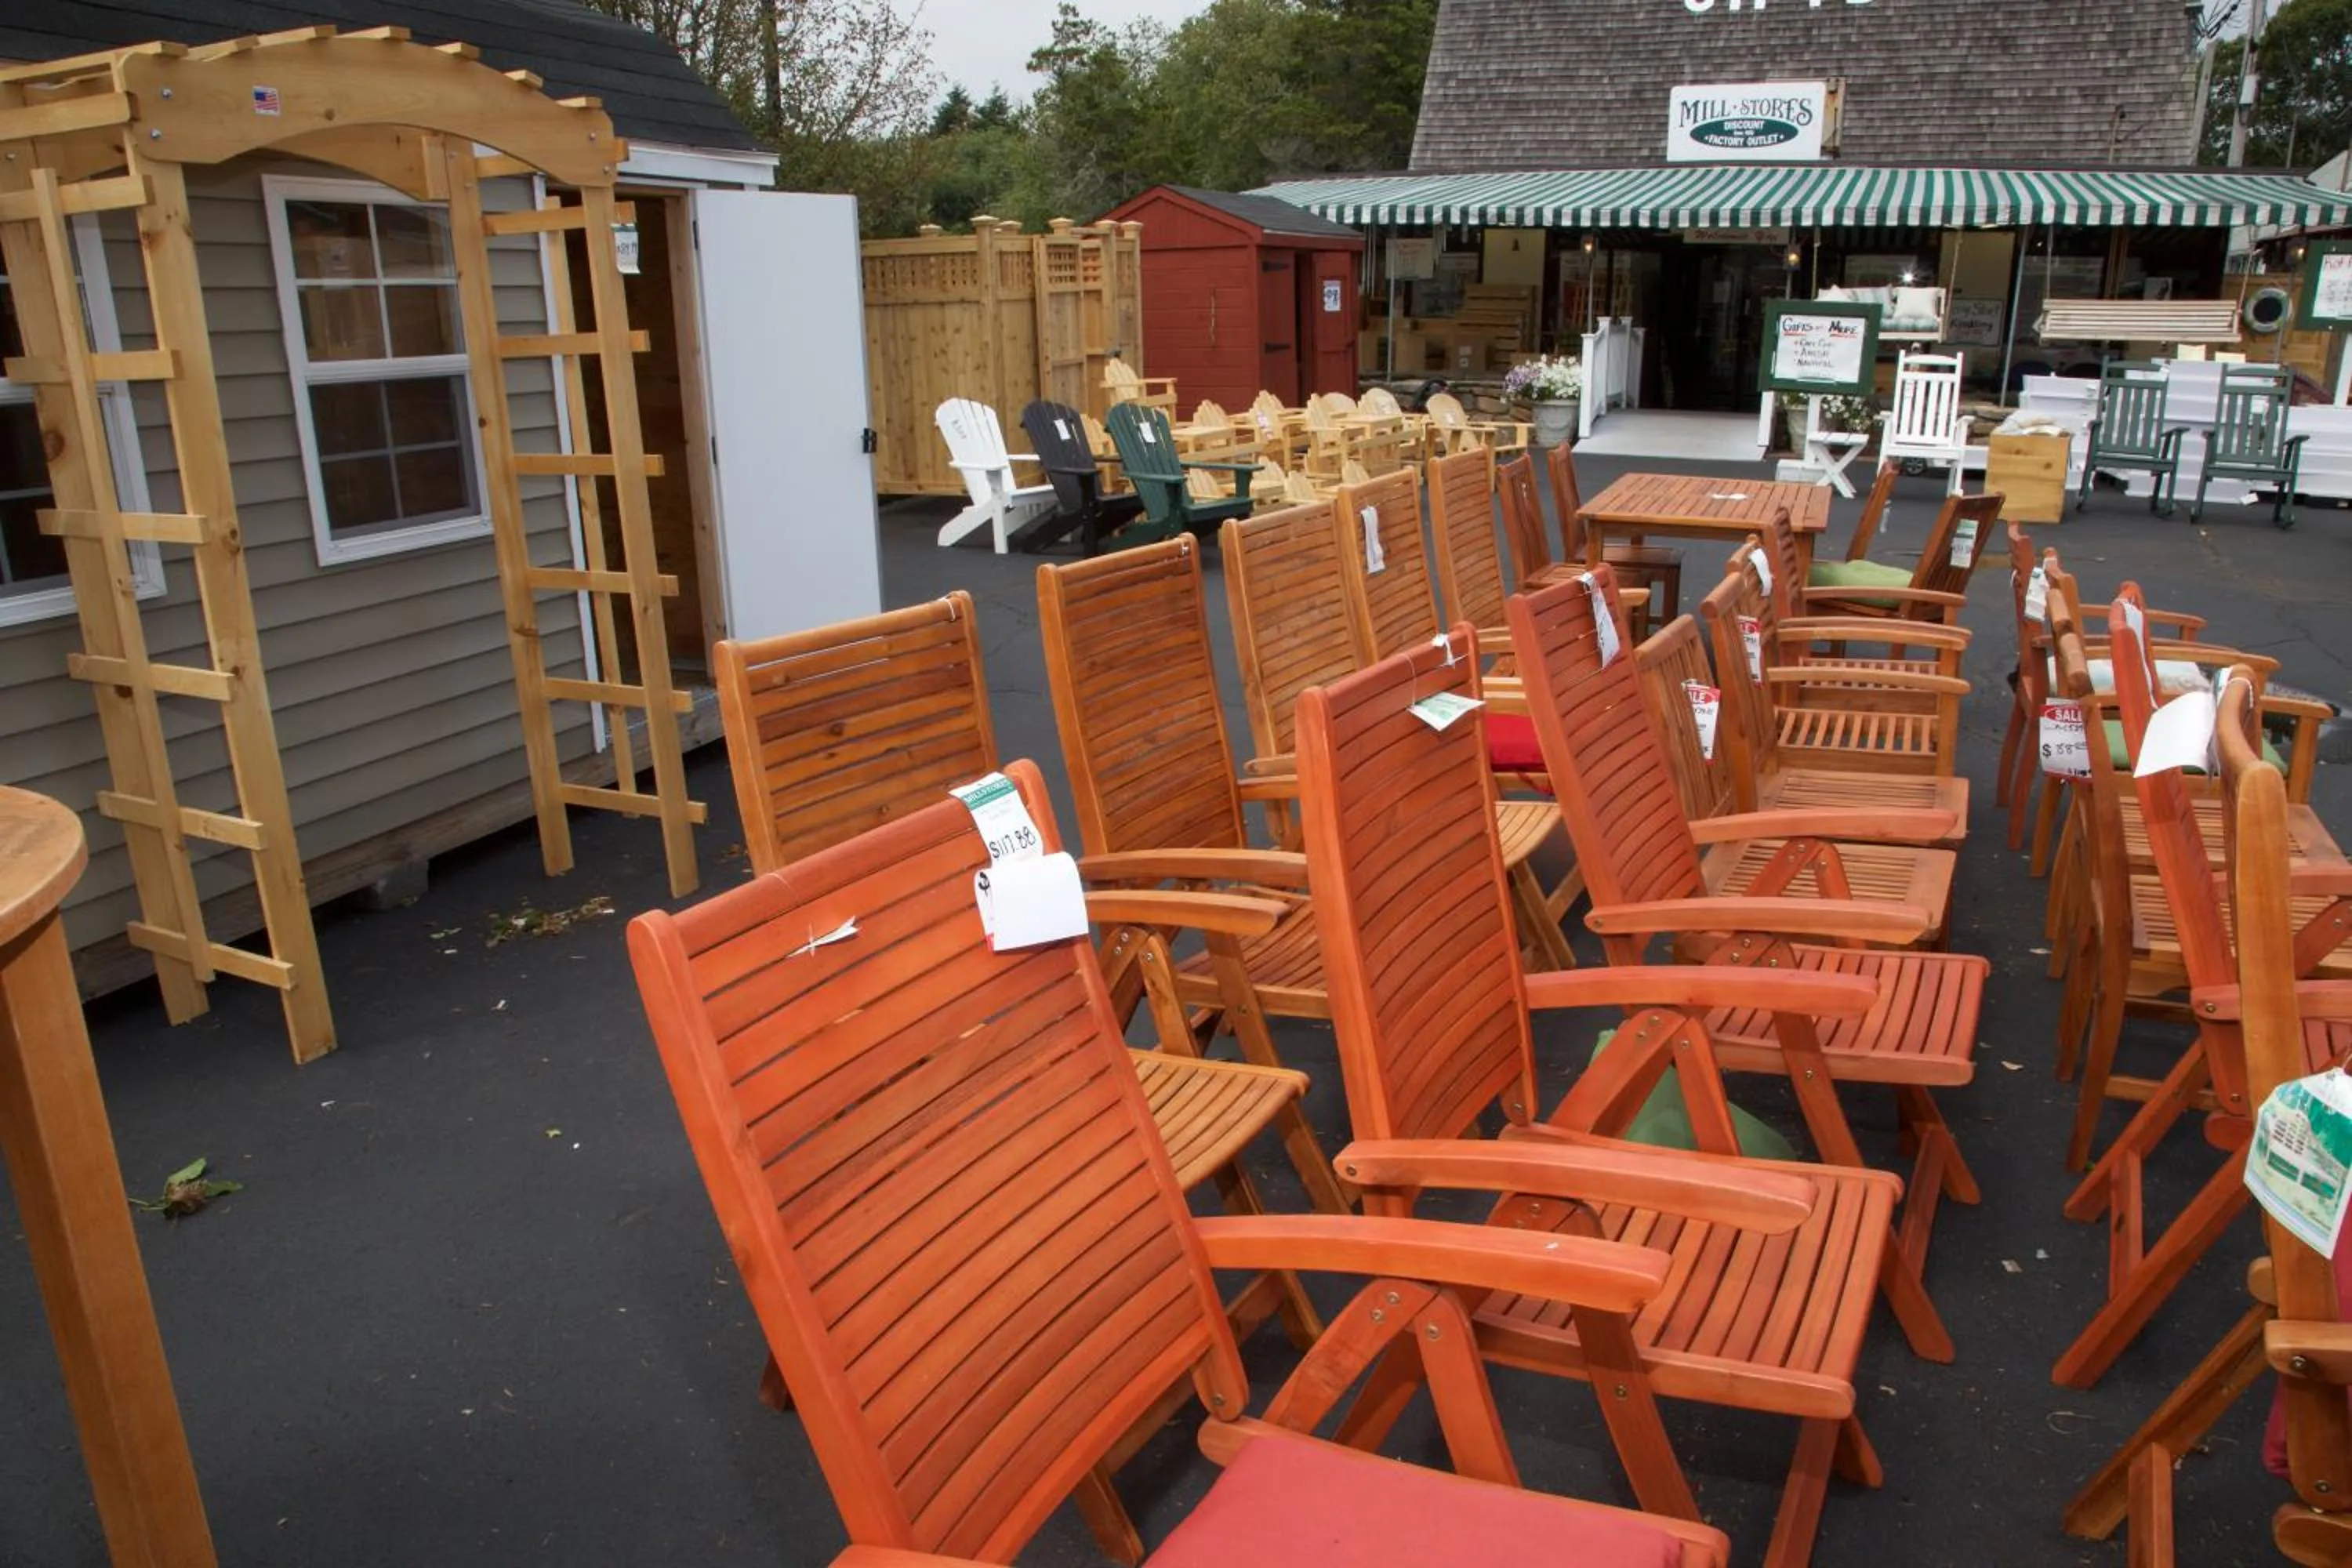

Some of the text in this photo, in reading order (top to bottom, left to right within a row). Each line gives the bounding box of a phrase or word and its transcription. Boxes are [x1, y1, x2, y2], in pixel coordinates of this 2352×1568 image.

[1679, 98, 1813, 127] MILL STORES
[1724, 121, 1765, 130] DISCOUNT
[1708, 133, 1778, 147] FACTORY OUTLET
